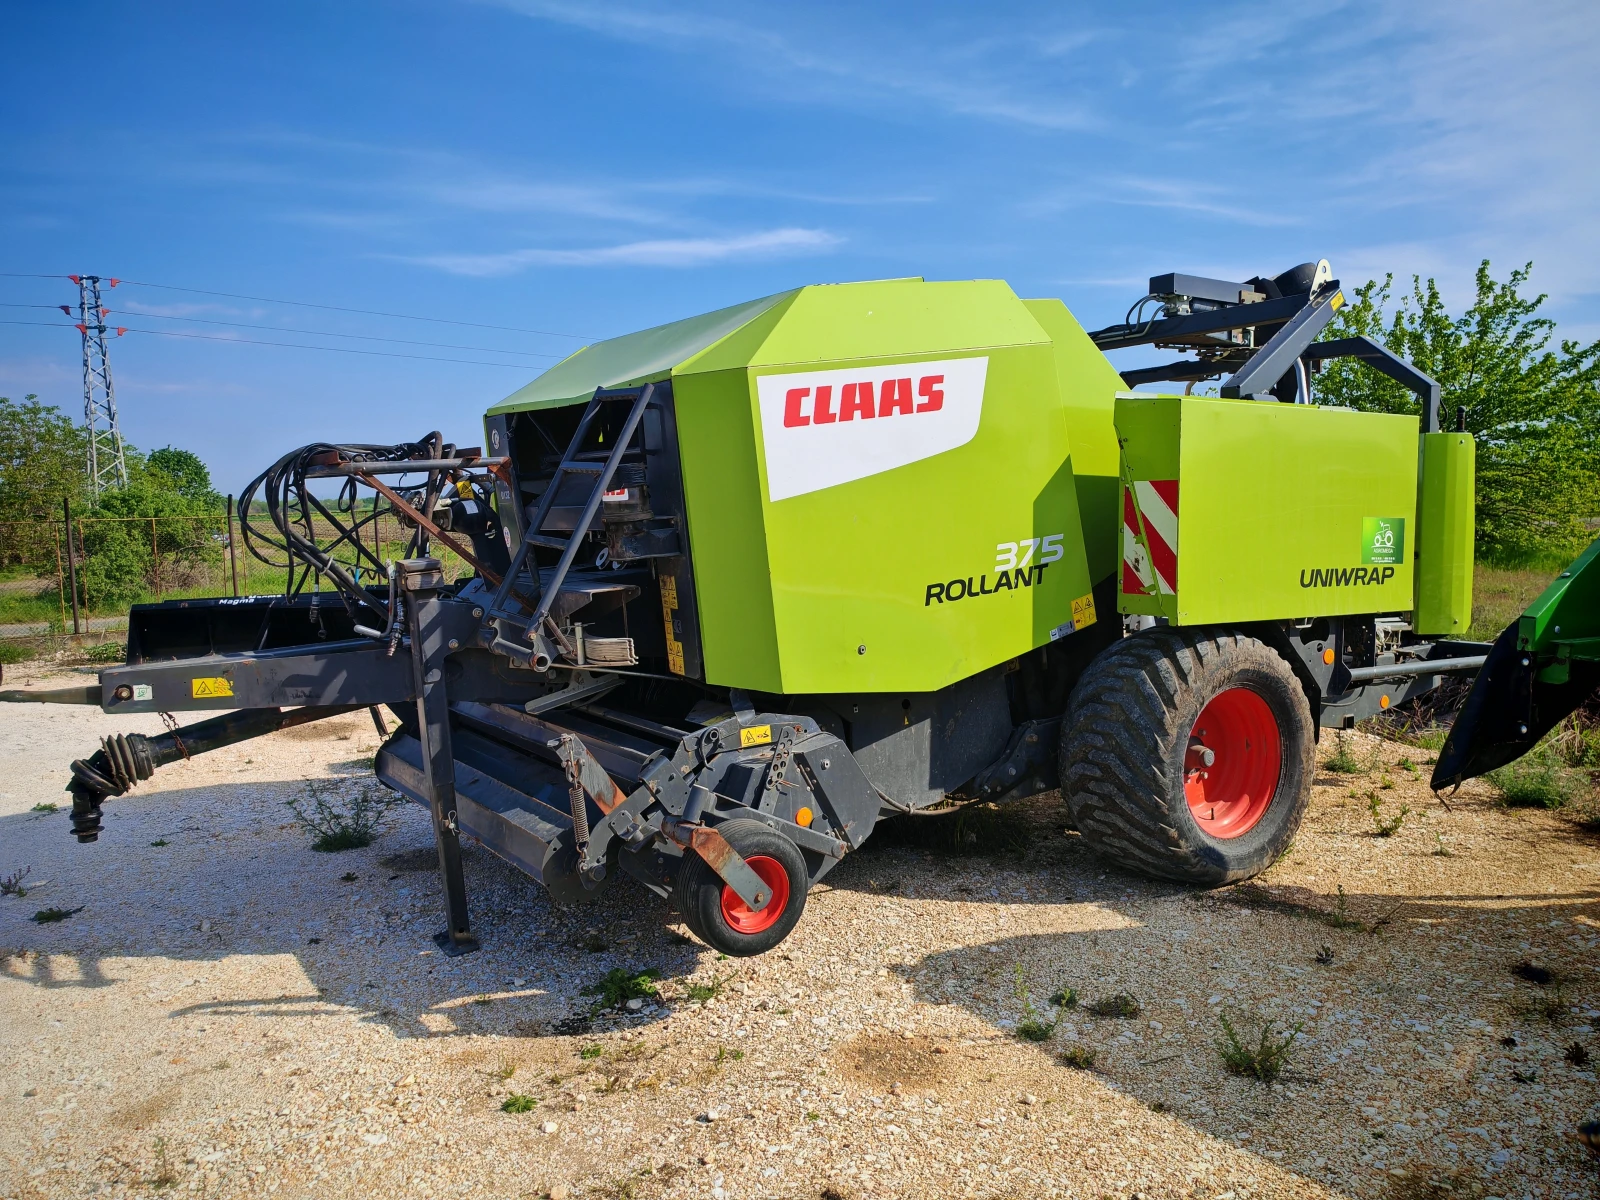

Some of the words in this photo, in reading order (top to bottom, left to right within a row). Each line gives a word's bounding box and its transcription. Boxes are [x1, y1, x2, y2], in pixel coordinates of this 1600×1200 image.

[784, 375, 944, 428] CLAAS
[995, 534, 1064, 572] 375
[925, 563, 1049, 606] ROLLANT
[1300, 567, 1395, 588] UNIWRAP
